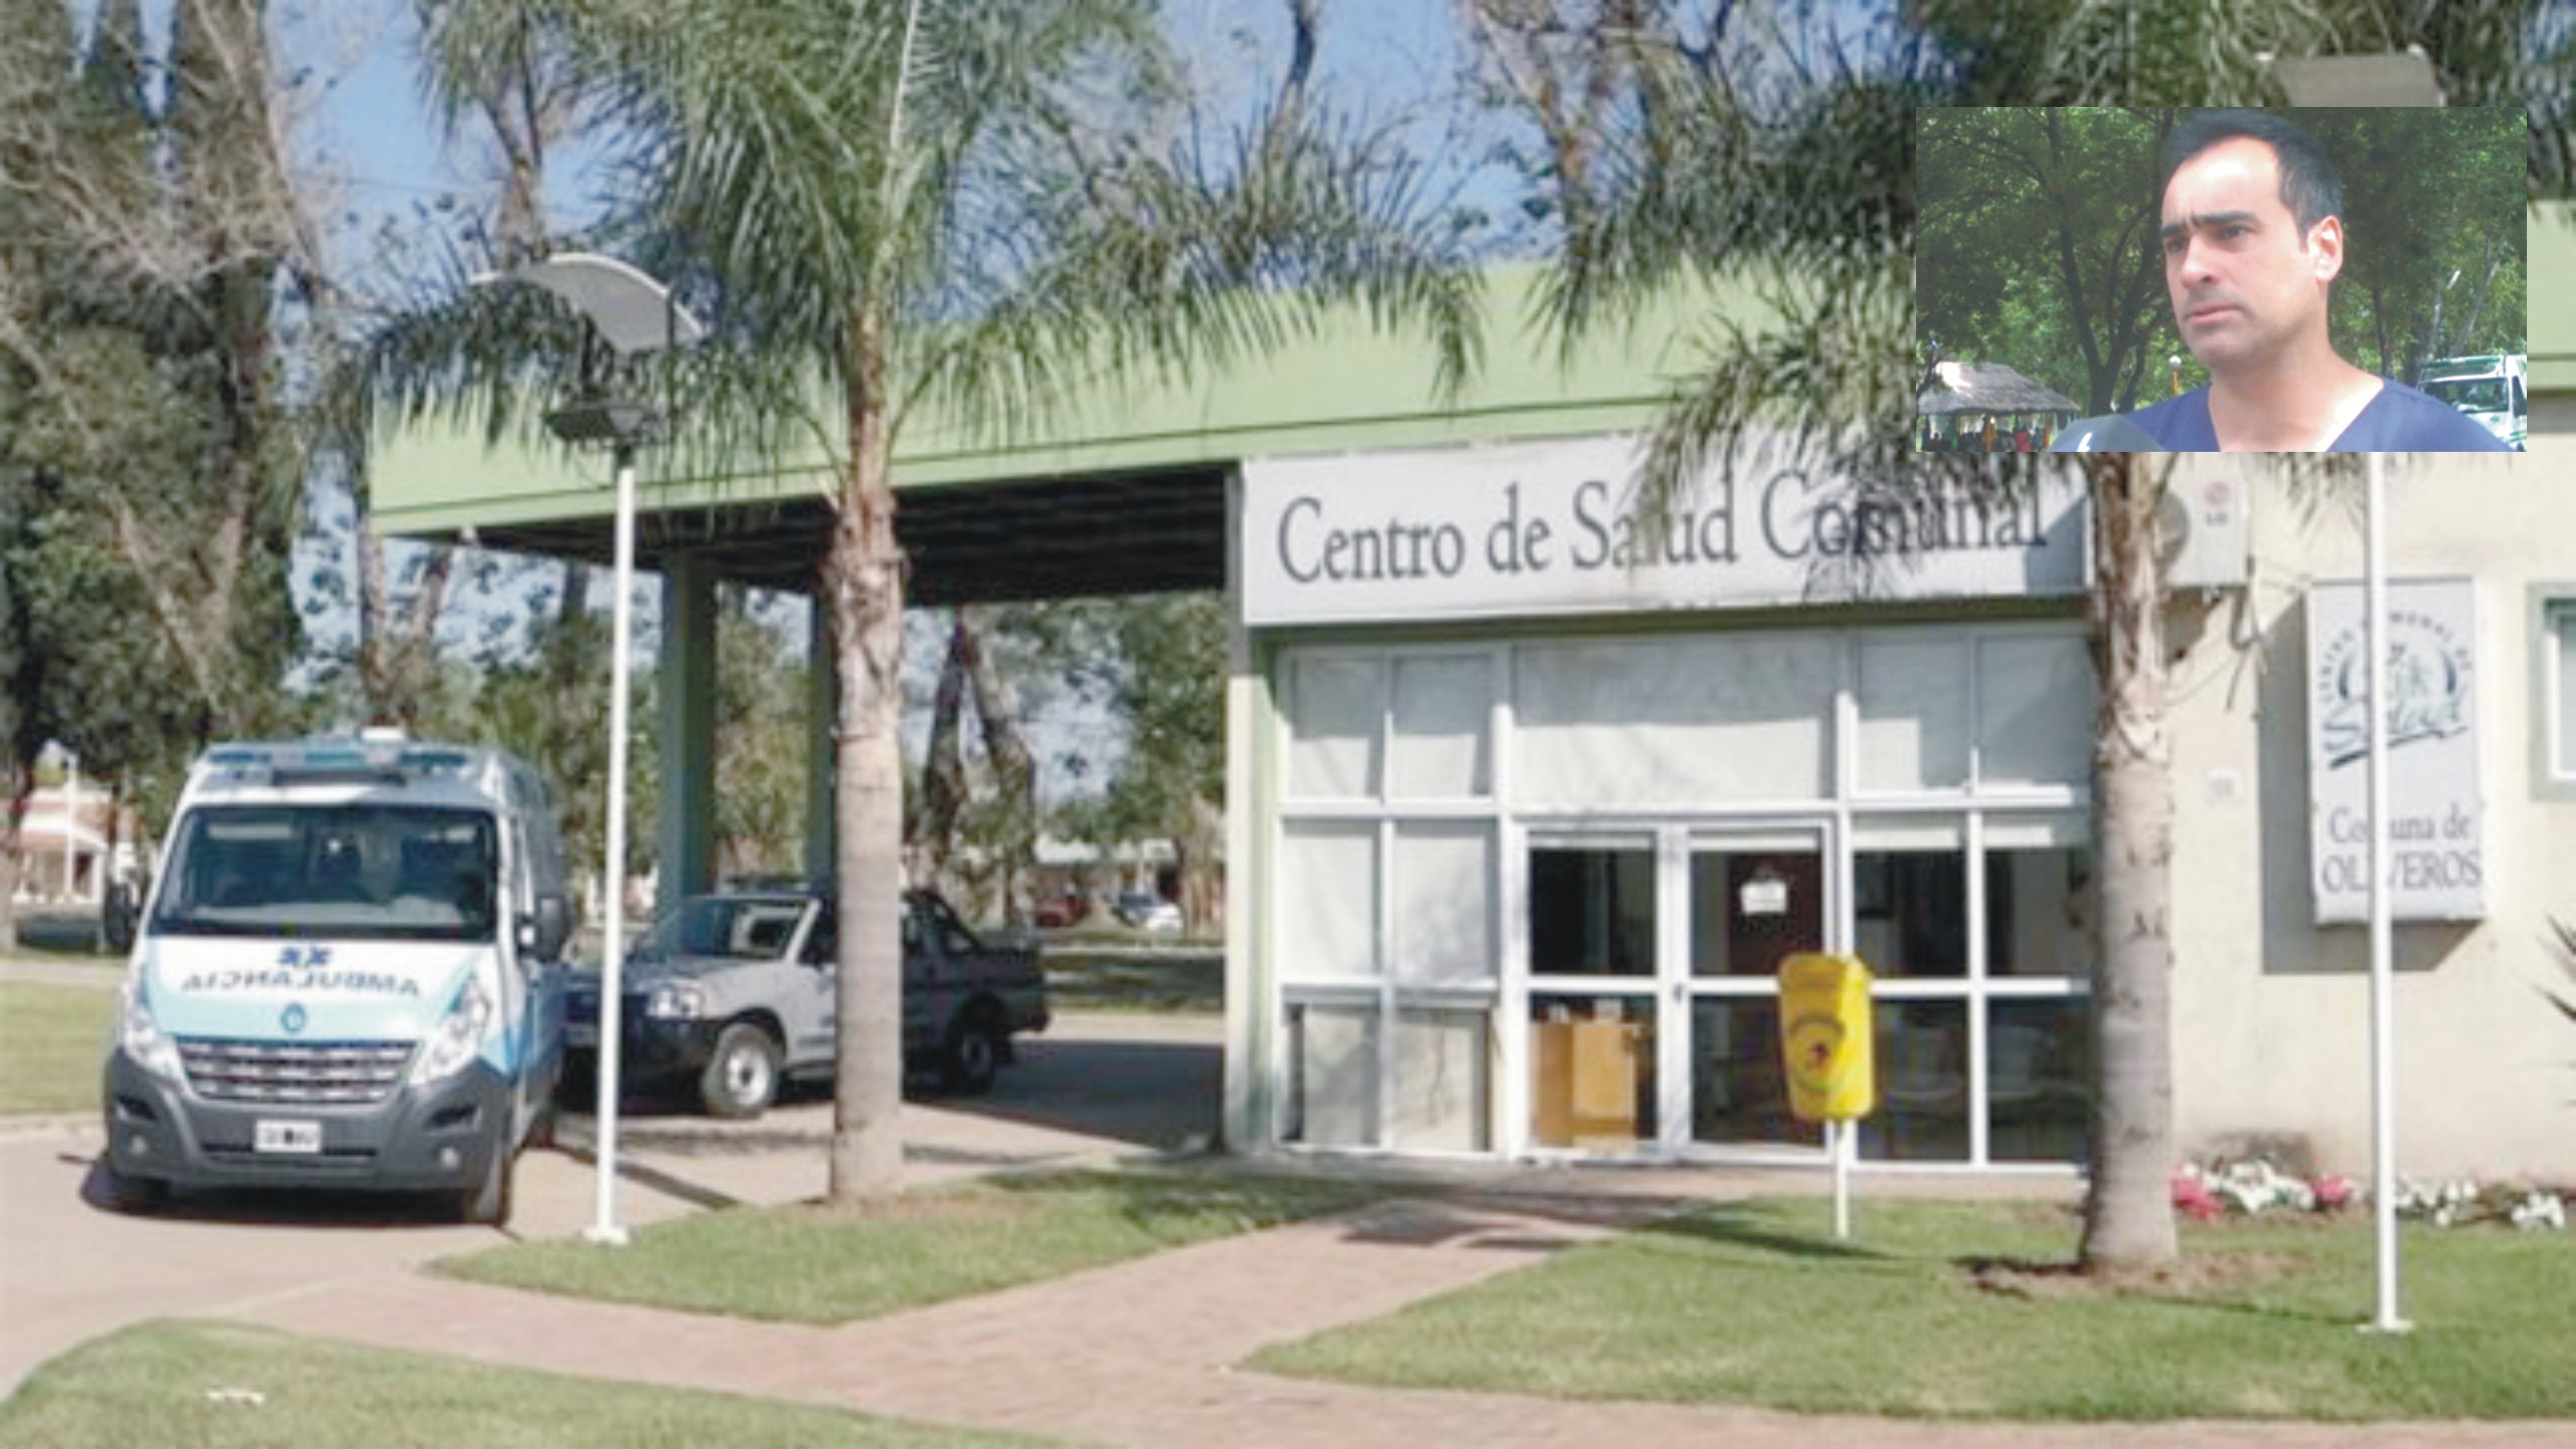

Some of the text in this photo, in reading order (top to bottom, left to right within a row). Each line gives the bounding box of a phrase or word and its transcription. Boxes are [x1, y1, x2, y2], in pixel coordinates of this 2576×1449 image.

[1277, 493, 1466, 583] Centro
[1486, 479, 1552, 575] de
[2327, 802, 2472, 844] Couna de
[2321, 849, 2483, 893] OLVEROS
